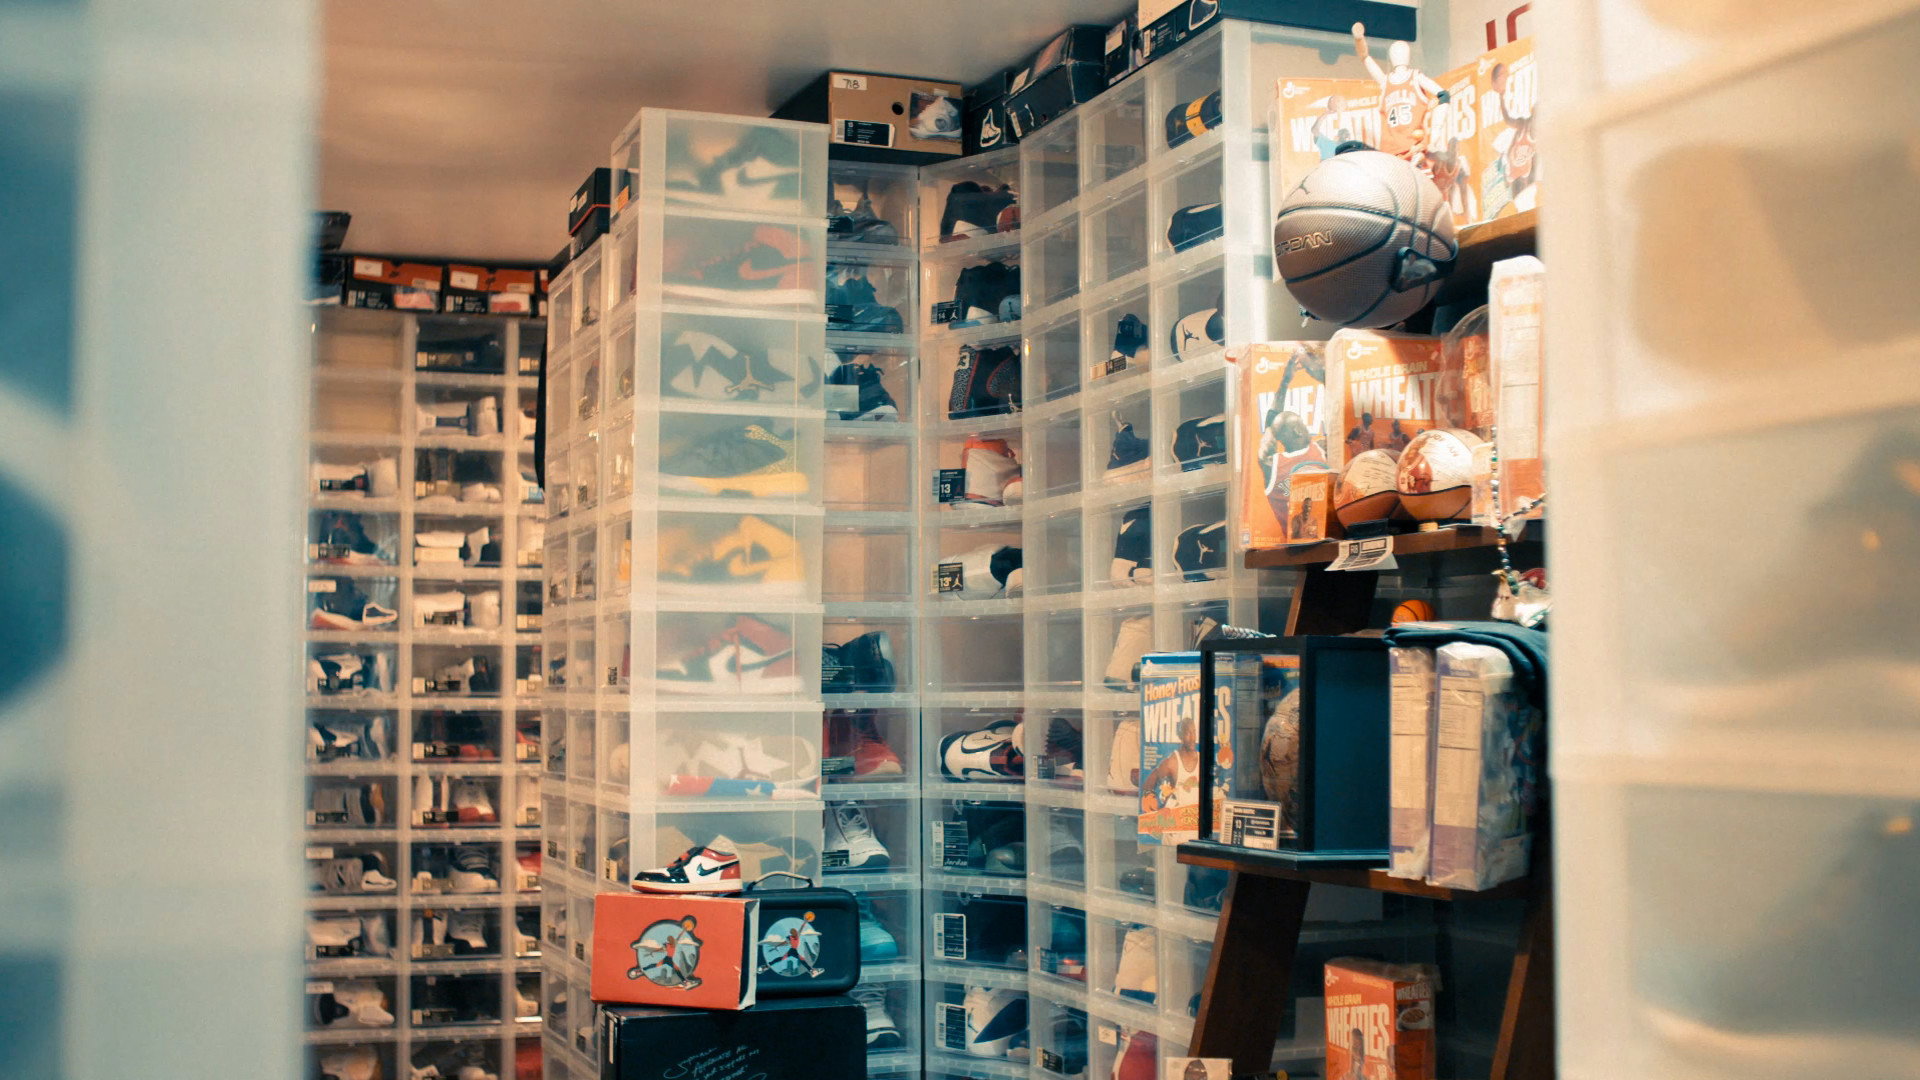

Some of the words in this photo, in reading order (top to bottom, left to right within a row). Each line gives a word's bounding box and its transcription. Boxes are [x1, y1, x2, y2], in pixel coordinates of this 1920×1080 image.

[1388, 105, 1412, 128] 45
[940, 483, 951, 494] 13
[939, 576, 951, 588] 13
[1144, 681, 1177, 702] Honey
[1327, 1003, 1390, 1061] WHEATIES
